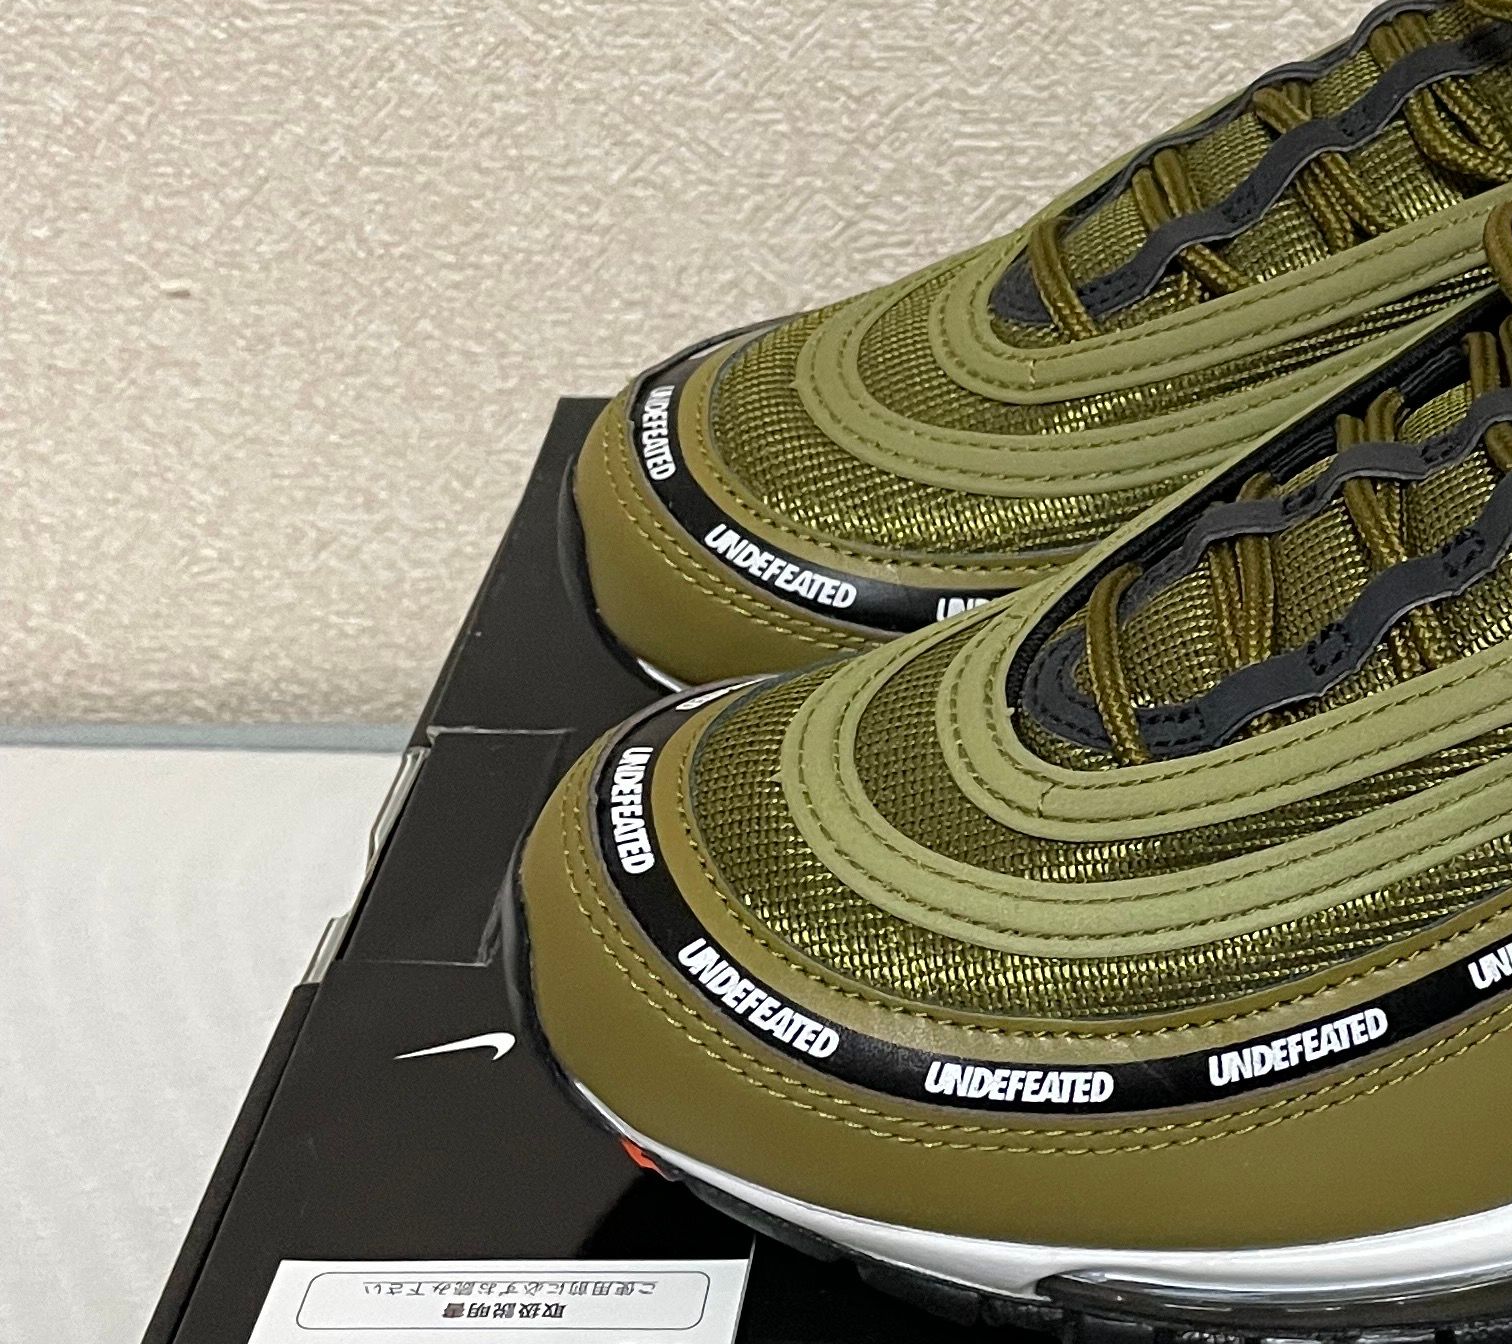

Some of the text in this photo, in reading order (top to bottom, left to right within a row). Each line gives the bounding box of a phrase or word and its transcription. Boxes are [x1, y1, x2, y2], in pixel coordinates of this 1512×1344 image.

[642, 386, 676, 480] UNDEFEATED
[704, 524, 857, 609] UNDEFEATED
[611, 747, 655, 874] UNDEFEATED
[677, 938, 840, 1058] UNDEFEATED
[924, 1061, 1114, 1103] UNDEFEATED
[1208, 1007, 1388, 1087] UNDEFEATED
[362, 1282, 657, 1296] ご使用前に必ずお読み下さい
[442, 1302, 566, 1319] 取扱説明書
